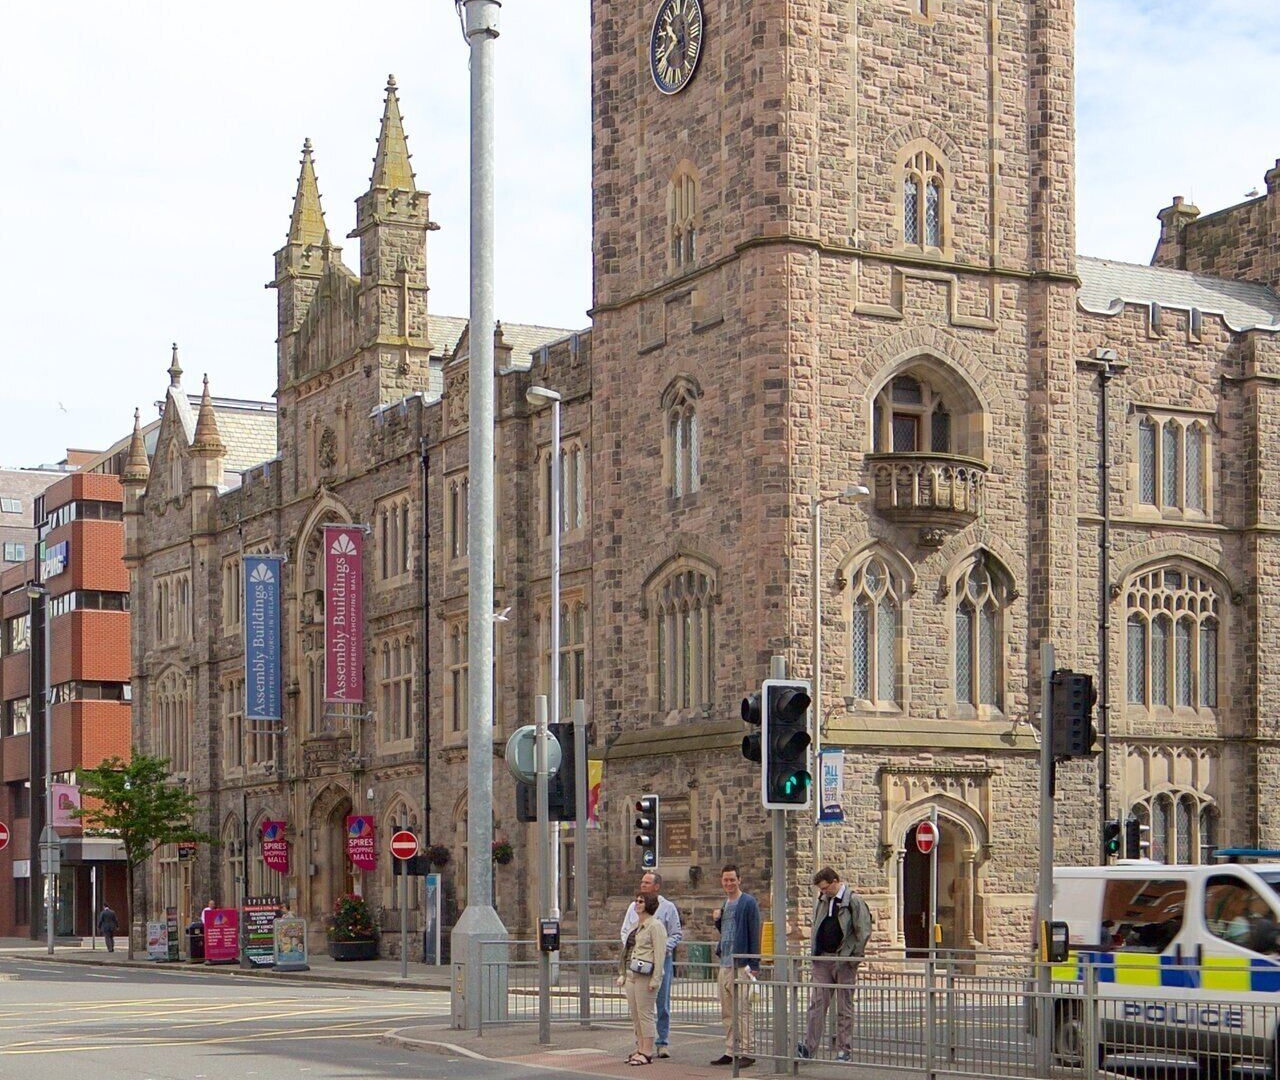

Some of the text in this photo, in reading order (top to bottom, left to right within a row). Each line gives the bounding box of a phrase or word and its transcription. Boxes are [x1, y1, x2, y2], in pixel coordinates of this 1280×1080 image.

[252, 584, 268, 714] Assembly Buildings
[332, 557, 349, 699] Assembly Buildings
[264, 842, 286, 850] SPIRES
[1123, 1004, 1244, 1028] POLICE
